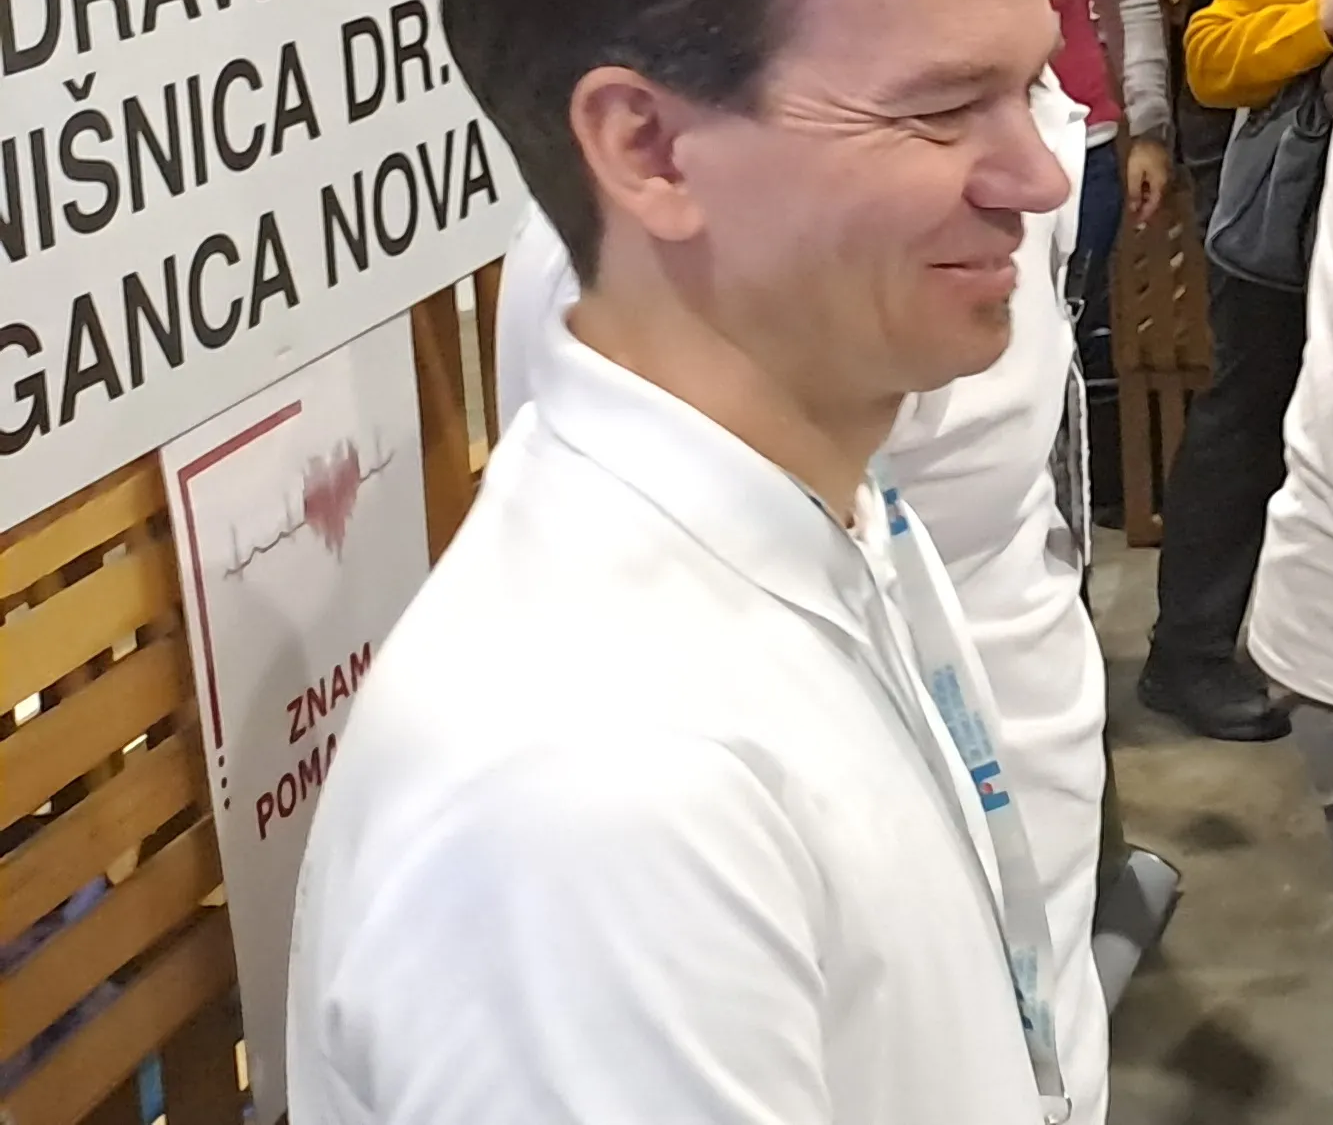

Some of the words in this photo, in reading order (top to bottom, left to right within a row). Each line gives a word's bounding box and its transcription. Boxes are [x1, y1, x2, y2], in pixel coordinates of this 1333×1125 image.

[342, 0, 450, 124] DR.
[0, 211, 300, 457] GANCA
[321, 119, 499, 287] NOVA
[286, 641, 371, 745] ZNAM
